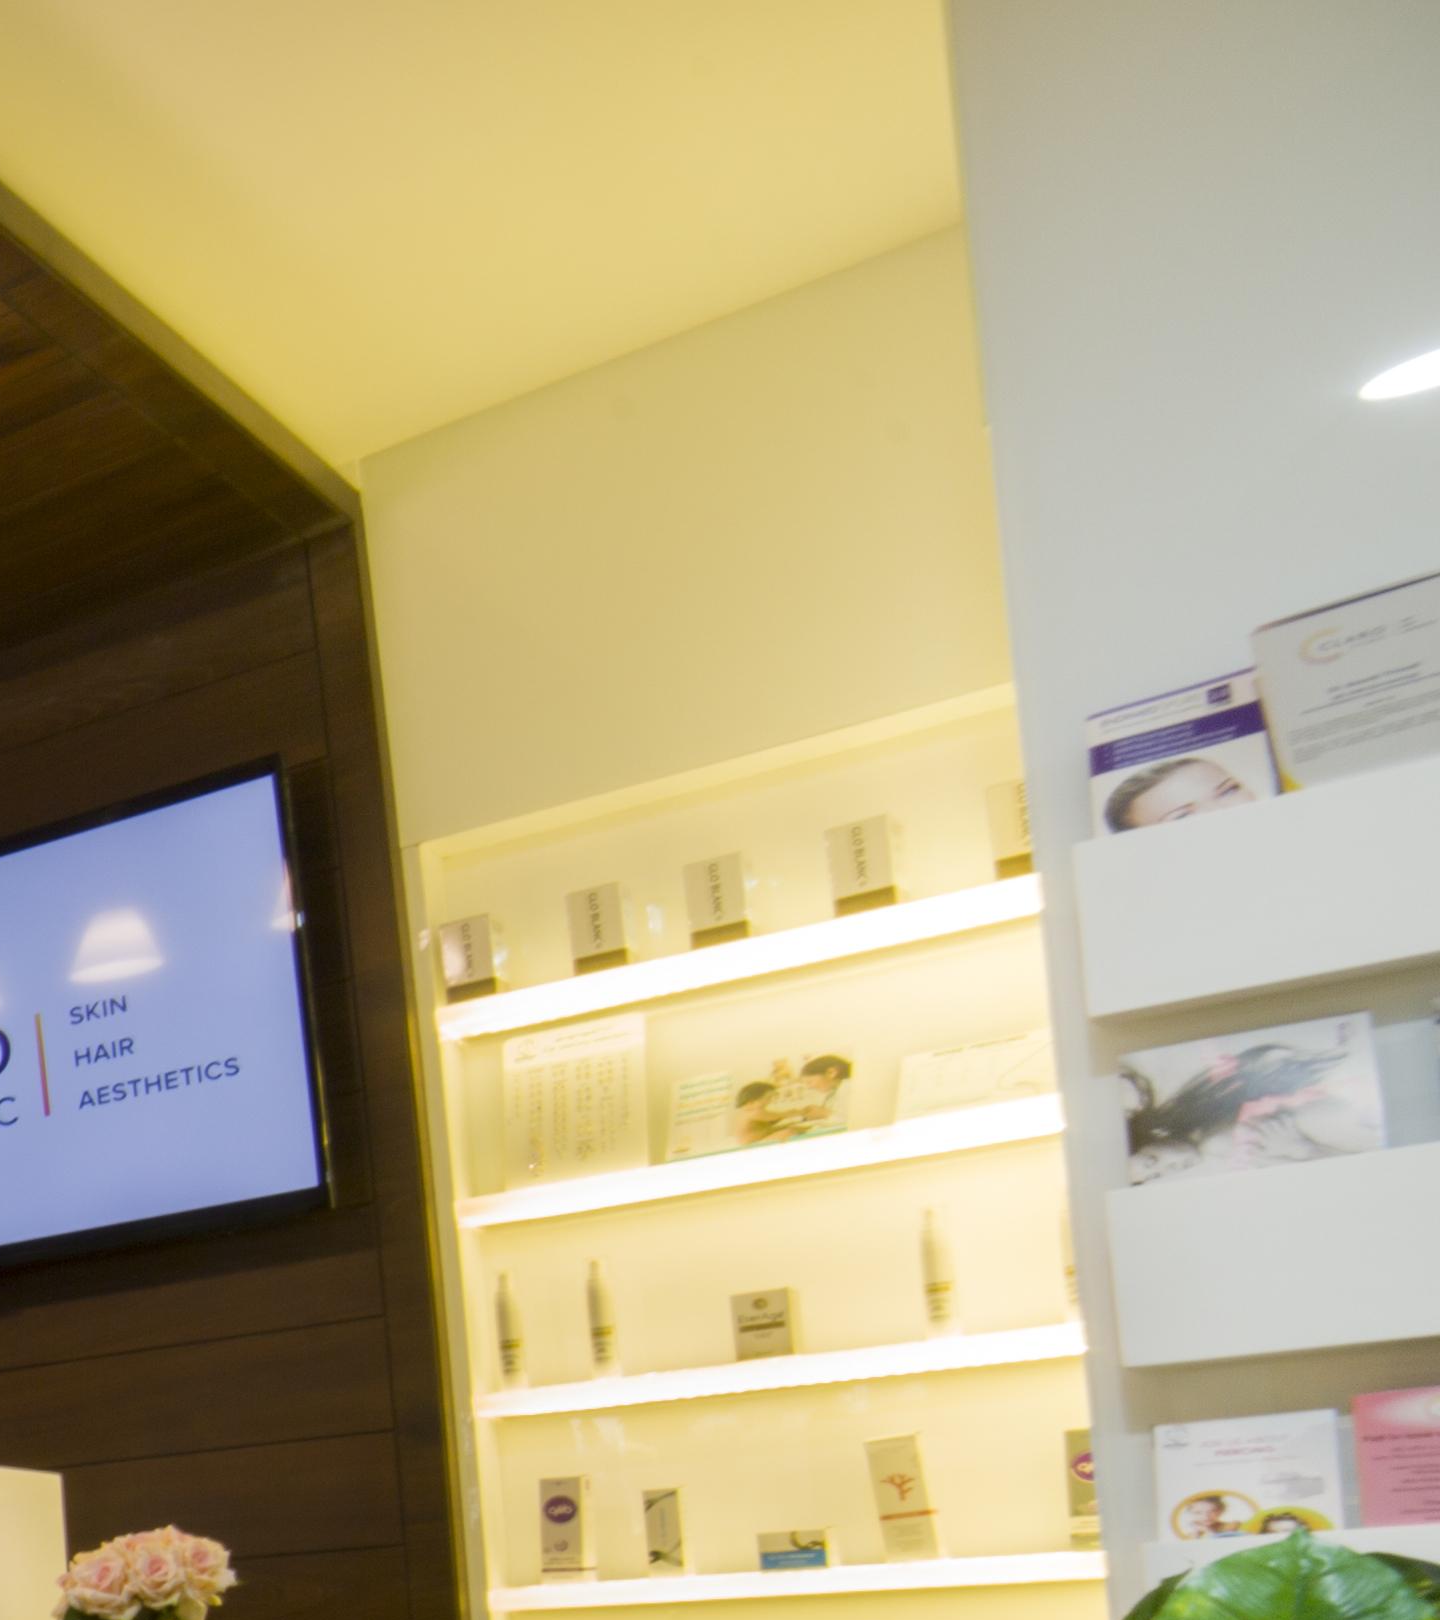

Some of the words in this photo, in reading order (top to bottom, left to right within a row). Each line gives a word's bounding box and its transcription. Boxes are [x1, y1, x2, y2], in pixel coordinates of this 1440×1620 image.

[69, 995, 129, 1026] SKIN
[73, 1036, 136, 1069] HAIR
[77, 1055, 242, 1111] AESTHETICS
